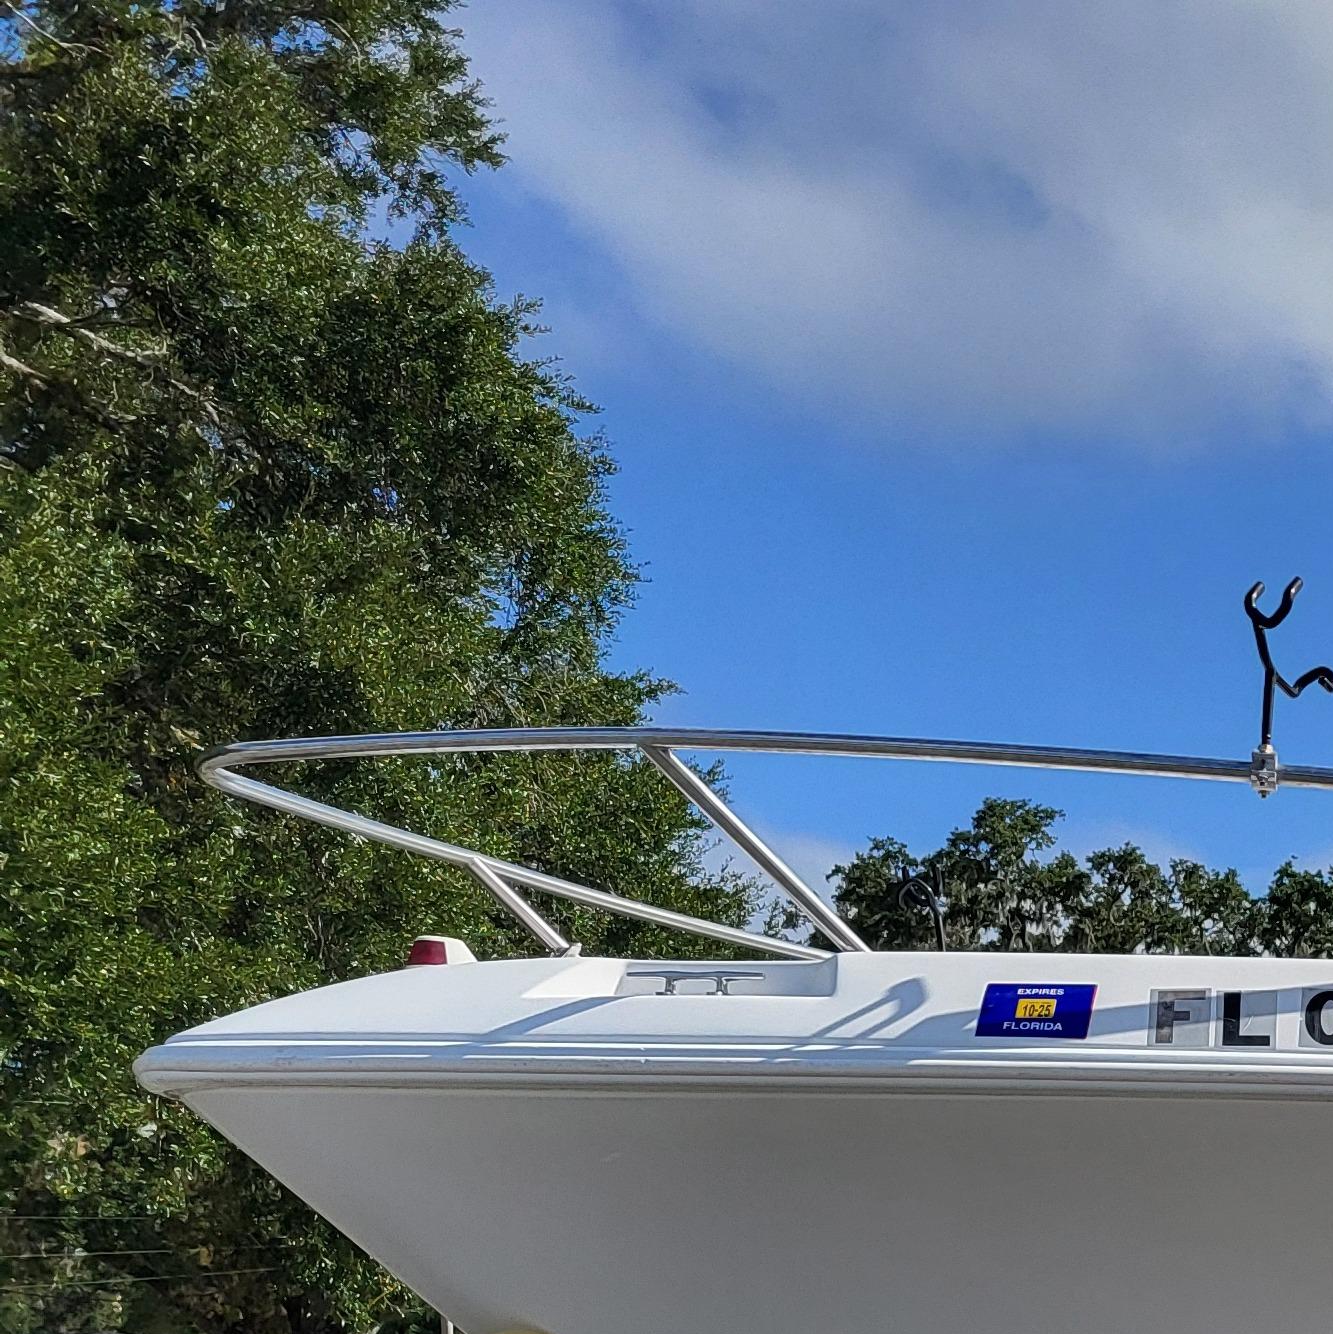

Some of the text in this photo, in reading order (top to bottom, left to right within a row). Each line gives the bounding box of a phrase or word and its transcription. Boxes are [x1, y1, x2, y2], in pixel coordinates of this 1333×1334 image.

[1017, 988, 1064, 996] EXPIRES
[1022, 1003, 1053, 1018] 10-25
[1154, 990, 1271, 1047] FL
[1002, 1021, 1063, 1031] FLORIDA
